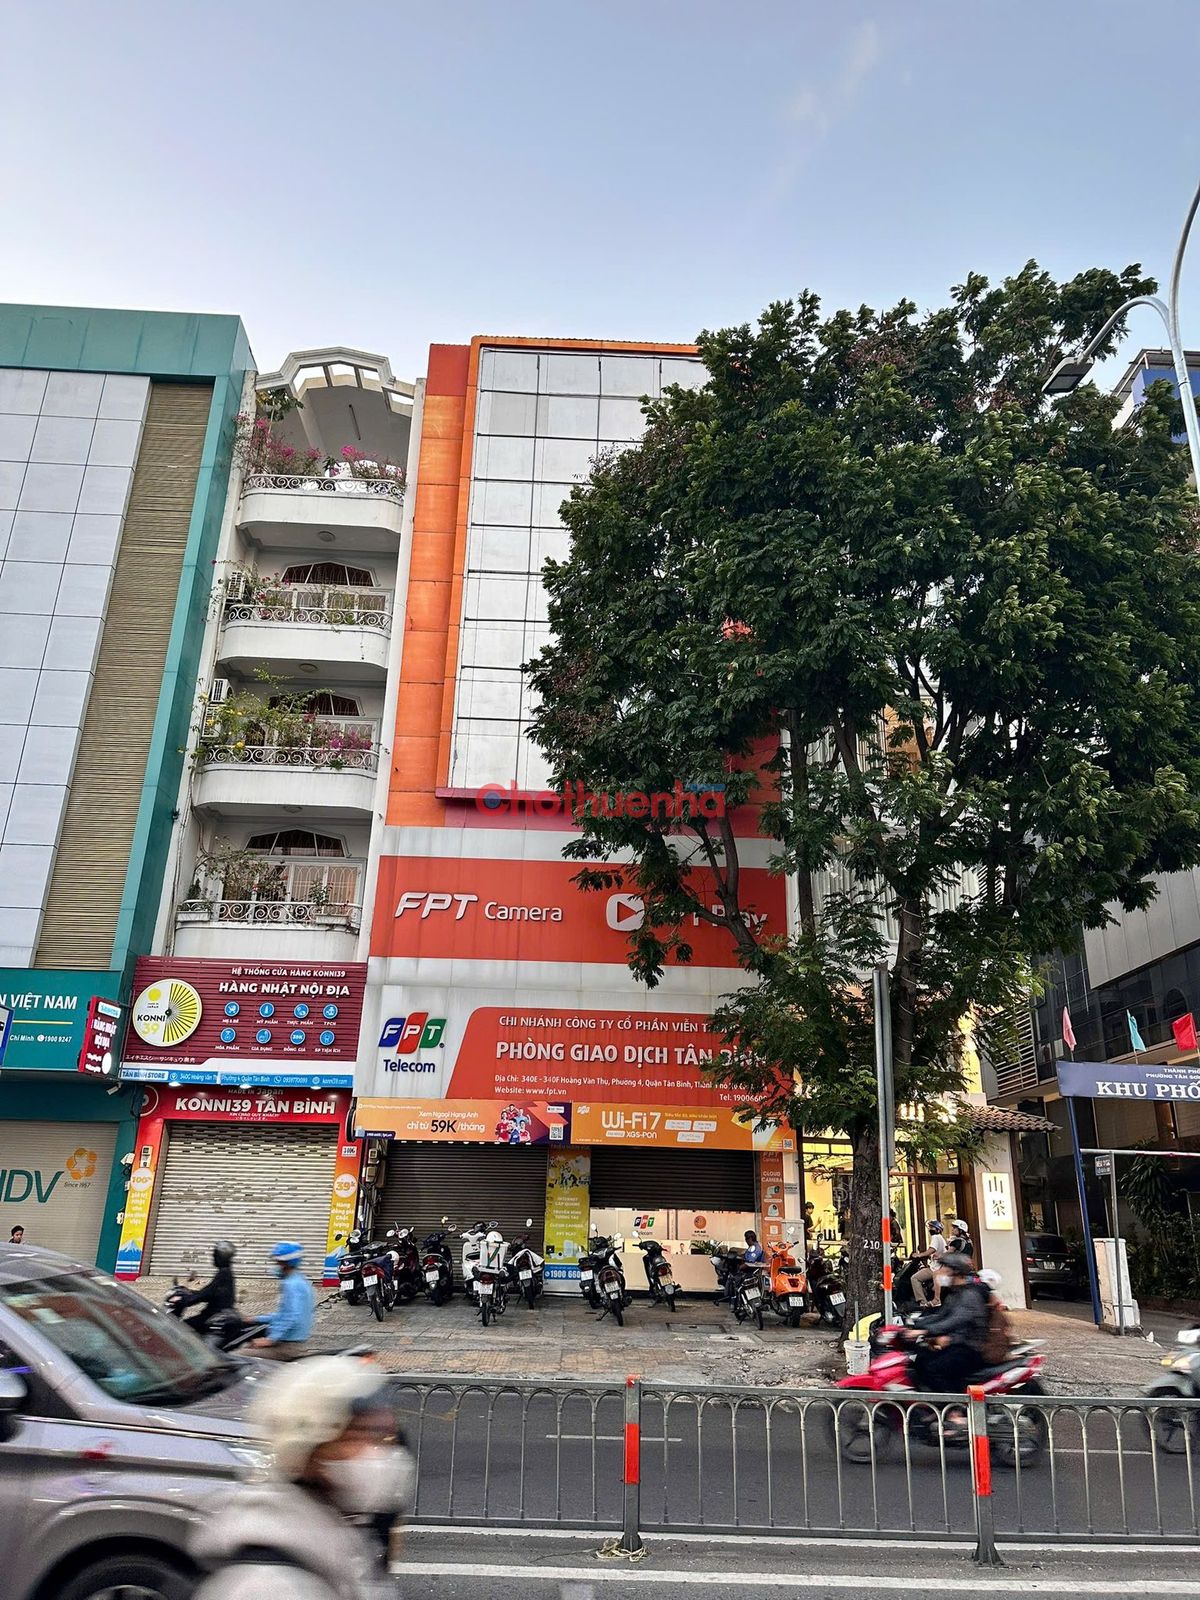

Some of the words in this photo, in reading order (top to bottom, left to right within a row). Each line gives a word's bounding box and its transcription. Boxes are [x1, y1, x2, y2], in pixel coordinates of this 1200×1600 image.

[394, 892, 479, 920] FPT
[484, 901, 563, 922] Camera
[231, 966, 242, 976] HỆ
[244, 966, 270, 976] THỐNG
[271, 967, 288, 976] CỬA
[290, 967, 311, 977] HÀNG
[313, 970, 346, 978] KONNI39
[219, 980, 258, 993] HÀNG
[261, 981, 297, 998] NHẬT
[300, 982, 323, 998] NỘI
[326, 984, 350, 999] ĐỊA
[10, 992, 42, 1010] VIỆT
[44, 996, 77, 1009] NAM
[137, 1014, 165, 1022] KONNI
[499, 1016, 517, 1026] CHI
[520, 1014, 562, 1027] NHÁNH
[565, 1015, 596, 1029] CÔNG
[600, 1019, 614, 1029] TY
[617, 1015, 632, 1030] CỔ
[635, 1017, 670, 1031] PHẦN
[672, 1018, 698, 1033] VIỄN
[496, 1037, 564, 1060] PHÒNG
[570, 1044, 618, 1062] GIAO
[624, 1045, 668, 1068] DỊCH
[675, 1043, 713, 1066] TÂN
[383, 1059, 436, 1073] Telecom
[147, 1071, 166, 1079] STORE
[561, 1076, 581, 1086] Hoàng
[645, 1080, 662, 1089] Quận
[256, 1087, 284, 1096] Japan
[495, 1086, 524, 1095] Website:
[526, 1087, 567, 1096] www.fpt.vn
[1096, 1081, 1147, 1097] KHU
[1155, 1081, 1200, 1099] PHỐ
[175, 1097, 252, 1112] KONNI39
[255, 1095, 290, 1113] TÂN
[292, 1098, 336, 1114] BÌNH
[433, 1111, 450, 1119] Ngoại
[450, 1111, 466, 1119] Hạng
[601, 1110, 647, 1129] Wi-Fi
[649, 1112, 661, 1130] 7
[406, 1120, 419, 1130] chỉ
[430, 1119, 457, 1133] 59K
[457, 1121, 486, 1133] /tháng
[863, 1239, 880, 1250] 210
[550, 1269, 567, 1279] 1900
